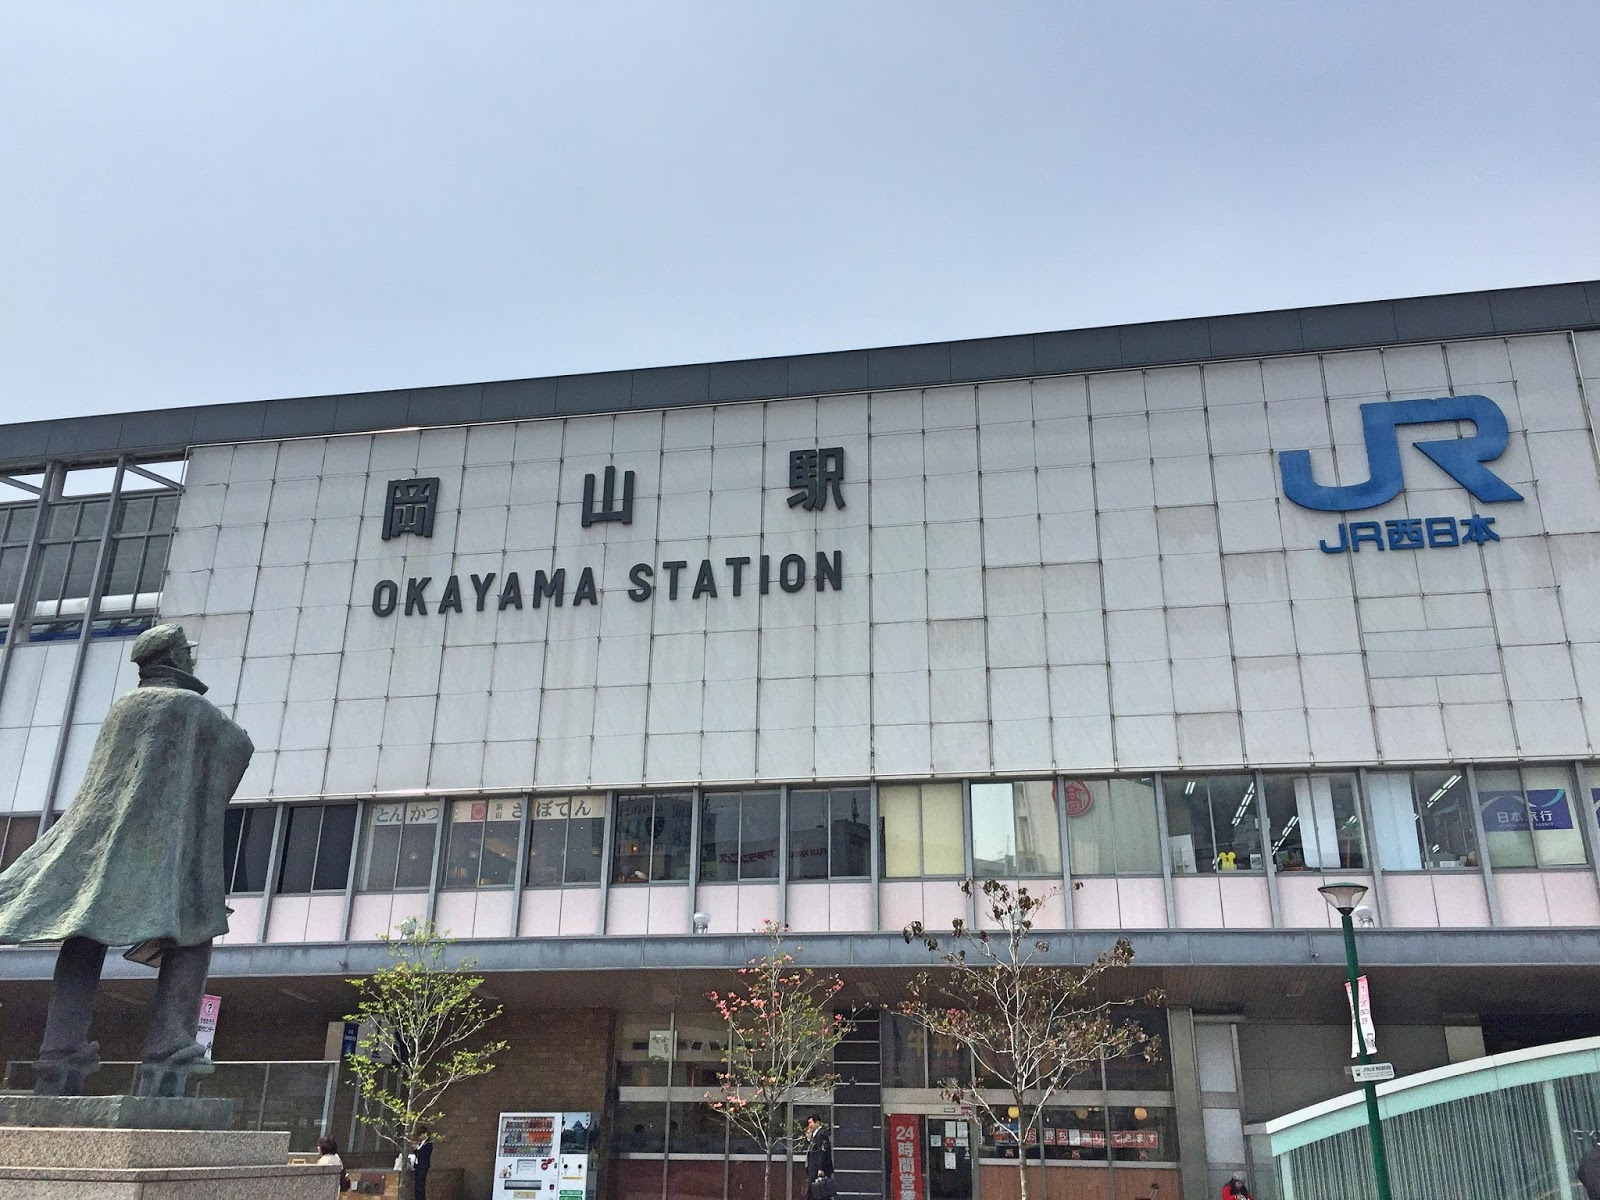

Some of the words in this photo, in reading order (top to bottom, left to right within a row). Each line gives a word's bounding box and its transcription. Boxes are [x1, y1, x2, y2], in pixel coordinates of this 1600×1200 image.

[1279, 395, 1525, 512] JR
[381, 447, 846, 541] 岡山駅
[1319, 514, 1500, 554] JR西日本
[372, 566, 599, 617] OKAYAMA
[628, 550, 843, 602] STATION
[377, 806, 439, 822] とんかつ
[511, 800, 591, 819] さぼてん
